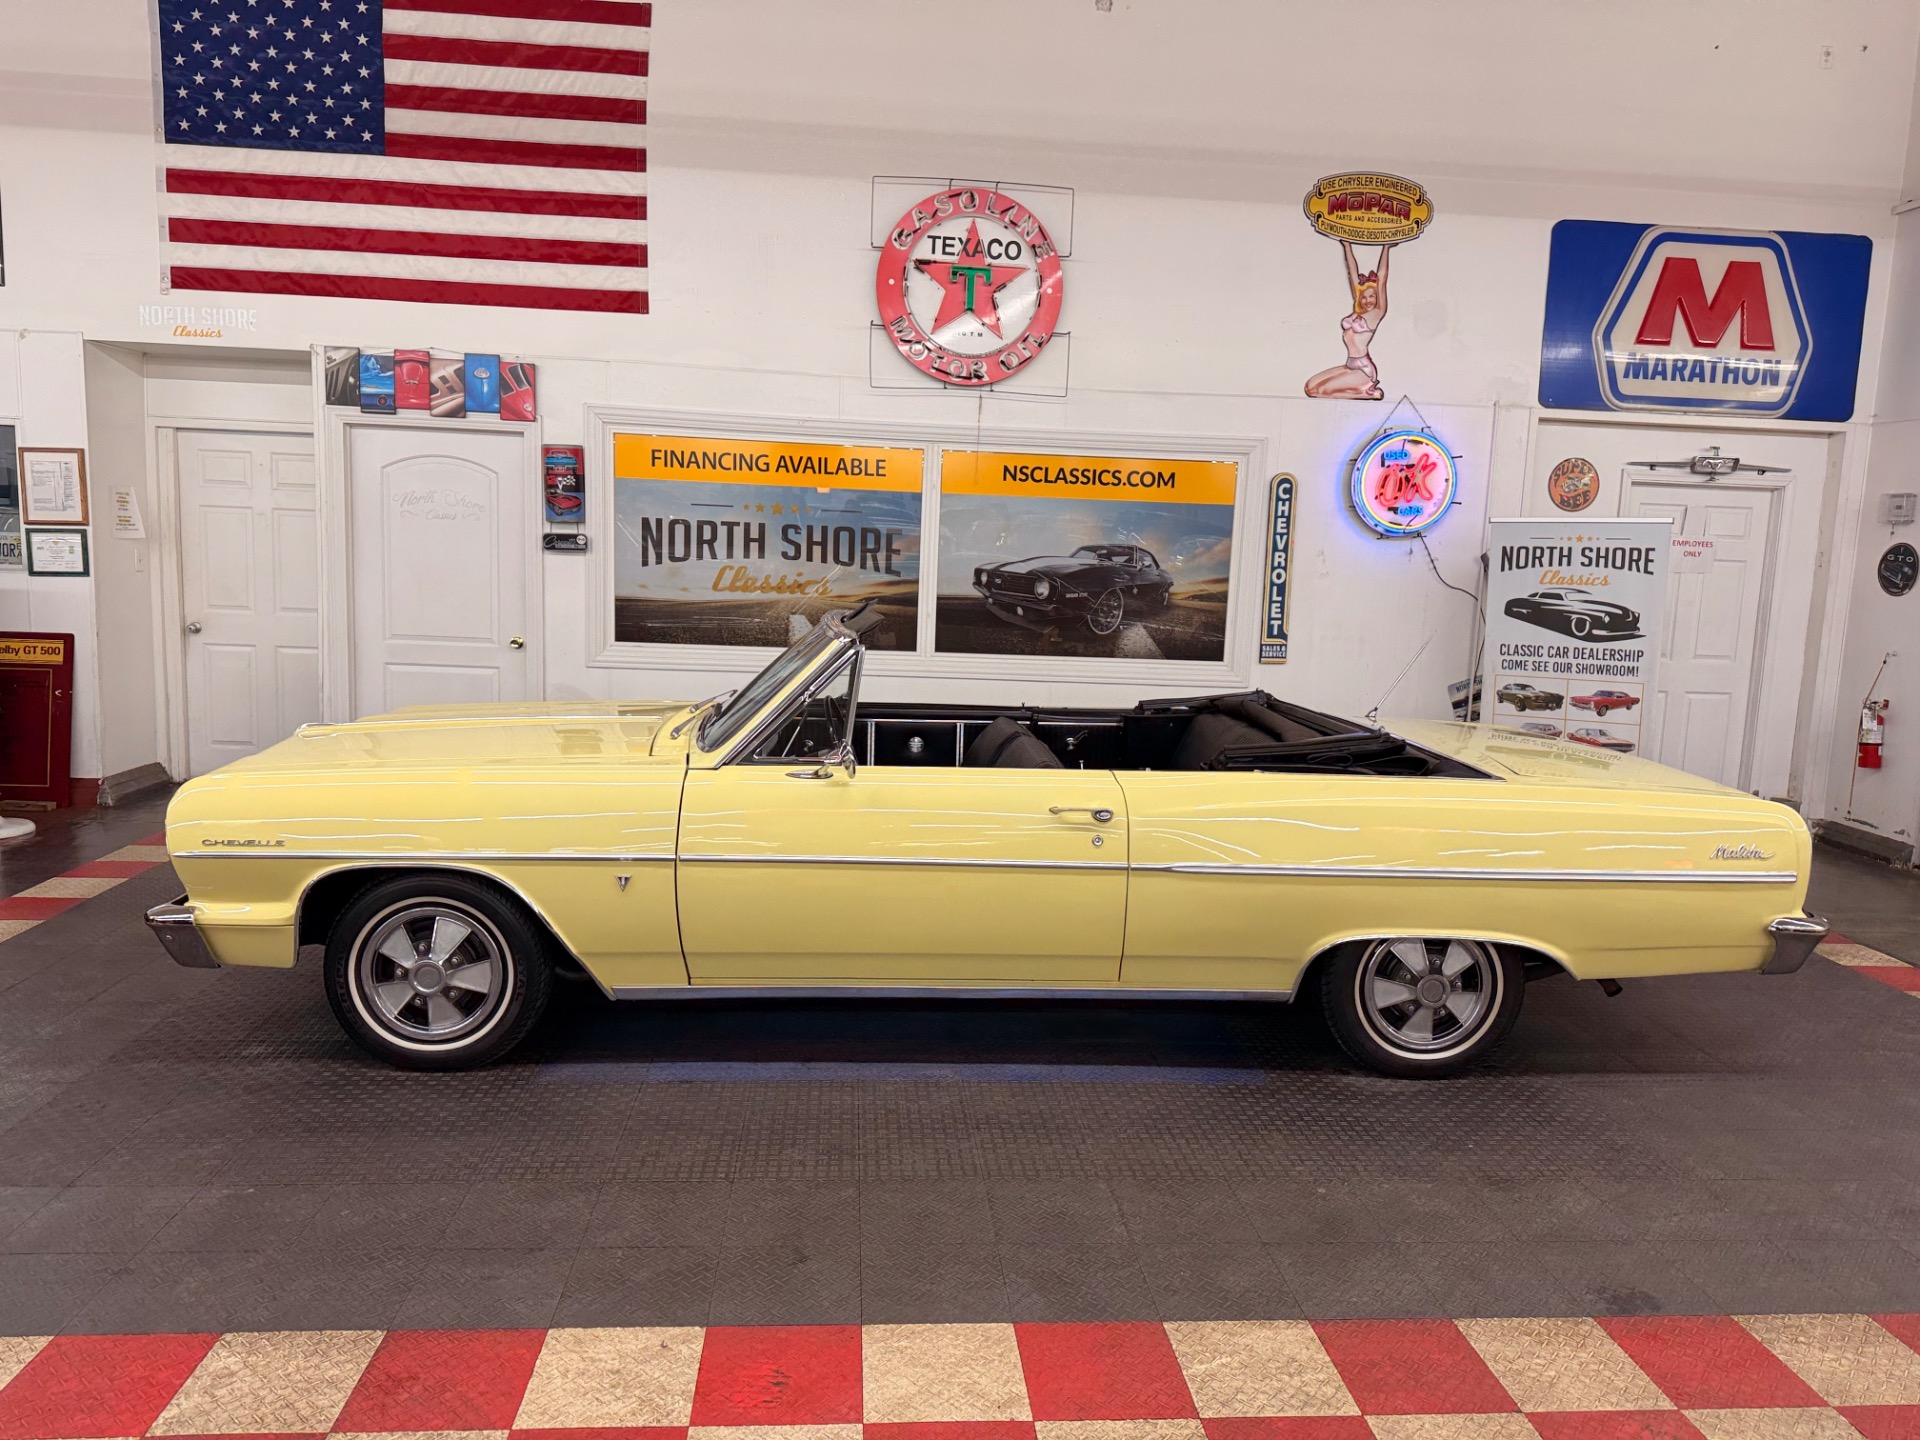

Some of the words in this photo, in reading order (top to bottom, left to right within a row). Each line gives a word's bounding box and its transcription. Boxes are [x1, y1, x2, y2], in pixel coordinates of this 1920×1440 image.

[1322, 180, 1336, 190] USE
[1338, 176, 1374, 188] CHRYSLER
[1375, 178, 1418, 196] ENGINEERED
[892, 190, 1054, 264] GASOLINE
[927, 235, 1022, 260] TEXACO
[950, 266, 992, 312] T
[1634, 257, 1776, 352] M
[139, 305, 196, 327] NORTH
[201, 307, 257, 332] SHORE
[172, 325, 223, 338] Classics
[890, 316, 990, 382] MOTOR
[999, 333, 1048, 370] OIL
[1622, 351, 1781, 386] MARATHON
[650, 449, 770, 473] FINANCING
[775, 455, 887, 477] AVAILABLE
[1383, 450, 1410, 460] USED
[1002, 464, 1176, 489] NSCLASSICS.COM
[1558, 490, 1590, 509] BEE
[1398, 506, 1423, 516] CARS
[641, 516, 766, 568] NORTH
[781, 524, 903, 578] SHORE
[1672, 540, 1714, 548] EMPLOYEES
[1270, 483, 1291, 636] CHEVROLET
[1500, 546, 1572, 573] NORTH
[1580, 546, 1656, 576] SHORE
[1887, 554, 1914, 563] GTO
[712, 565, 833, 596] Classics
[1538, 569, 1610, 587] Classics
[24, 646, 38, 654] GT
[40, 646, 60, 655] 500
[1500, 643, 1544, 658] CLASSIC
[1547, 645, 1570, 660] CAR
[1572, 646, 1644, 662] DEALERSHIP
[1501, 659, 1529, 671] COME
[1532, 660, 1550, 672] SEE
[1552, 662, 1573, 674] OUR
[1575, 662, 1640, 677] SHOWROOM!
[202, 839, 285, 847] CHEVELLE
[1709, 843, 1776, 861] Malibu
